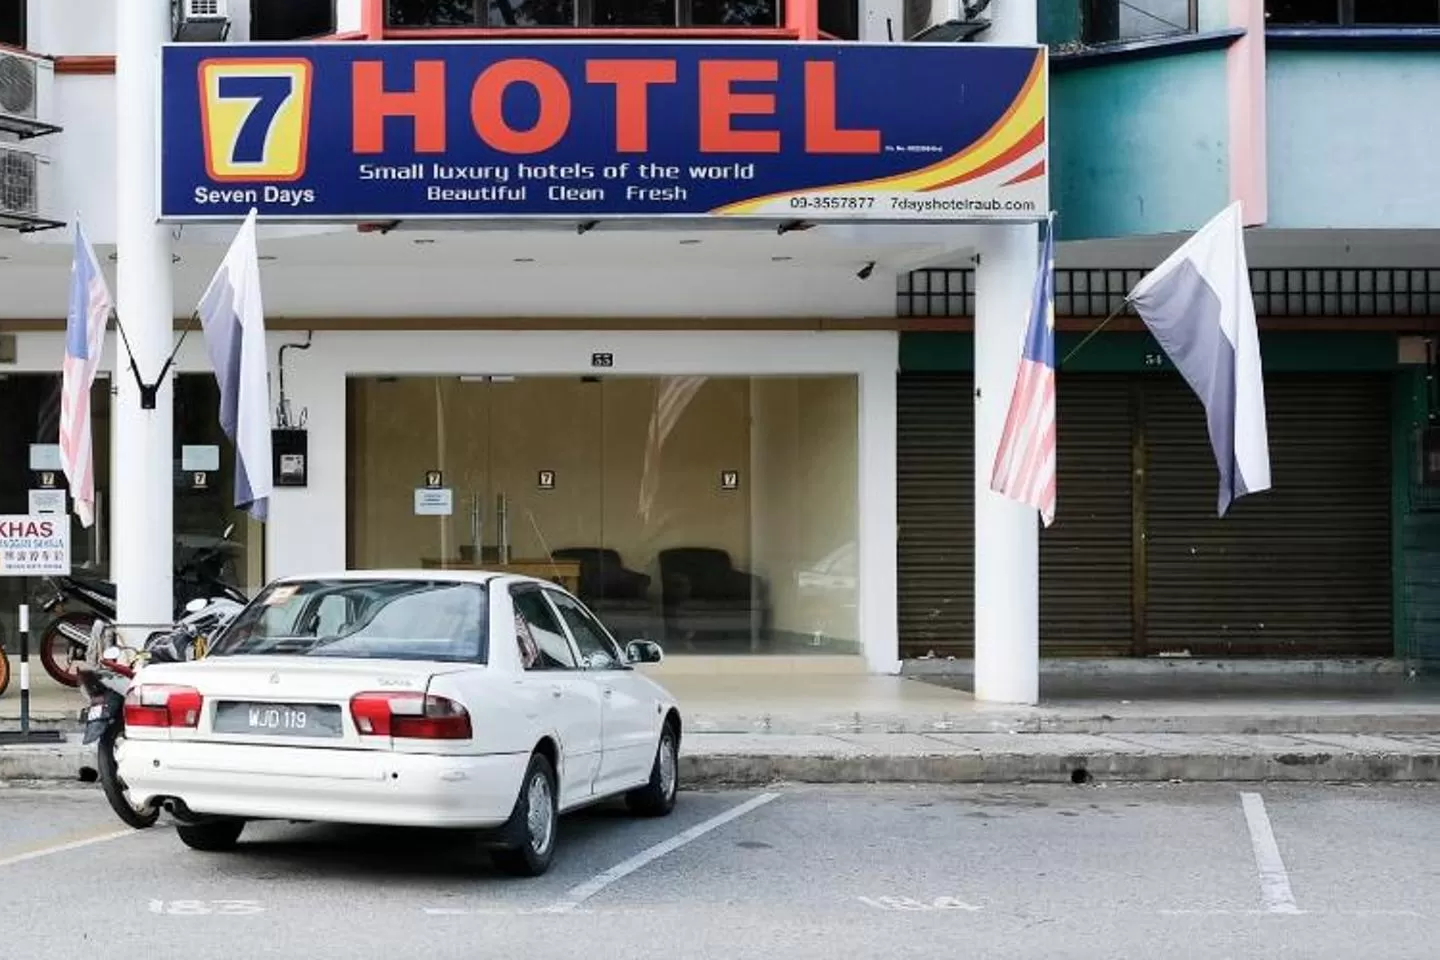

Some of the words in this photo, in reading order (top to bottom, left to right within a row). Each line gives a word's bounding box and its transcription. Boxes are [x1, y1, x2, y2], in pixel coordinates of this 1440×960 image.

[352, 59, 880, 154] HOTEL
[216, 74, 294, 165] 7
[359, 163, 424, 180] Small
[433, 163, 509, 182] luxury
[518, 163, 594, 179] hotels
[603, 163, 629, 179] of
[638, 163, 680, 179] the
[689, 163, 754, 179] world
[194, 186, 257, 203] Seven
[264, 186, 315, 207] Days
[427, 186, 526, 201] Beautiful
[548, 186, 604, 201] Clean
[626, 186, 687, 201] Fresh
[790, 196, 875, 209] 09-3557877
[890, 196, 1036, 212] 7dayshotelraub.com
[248, 710, 280, 729] WJD
[284, 711, 307, 729] 119
